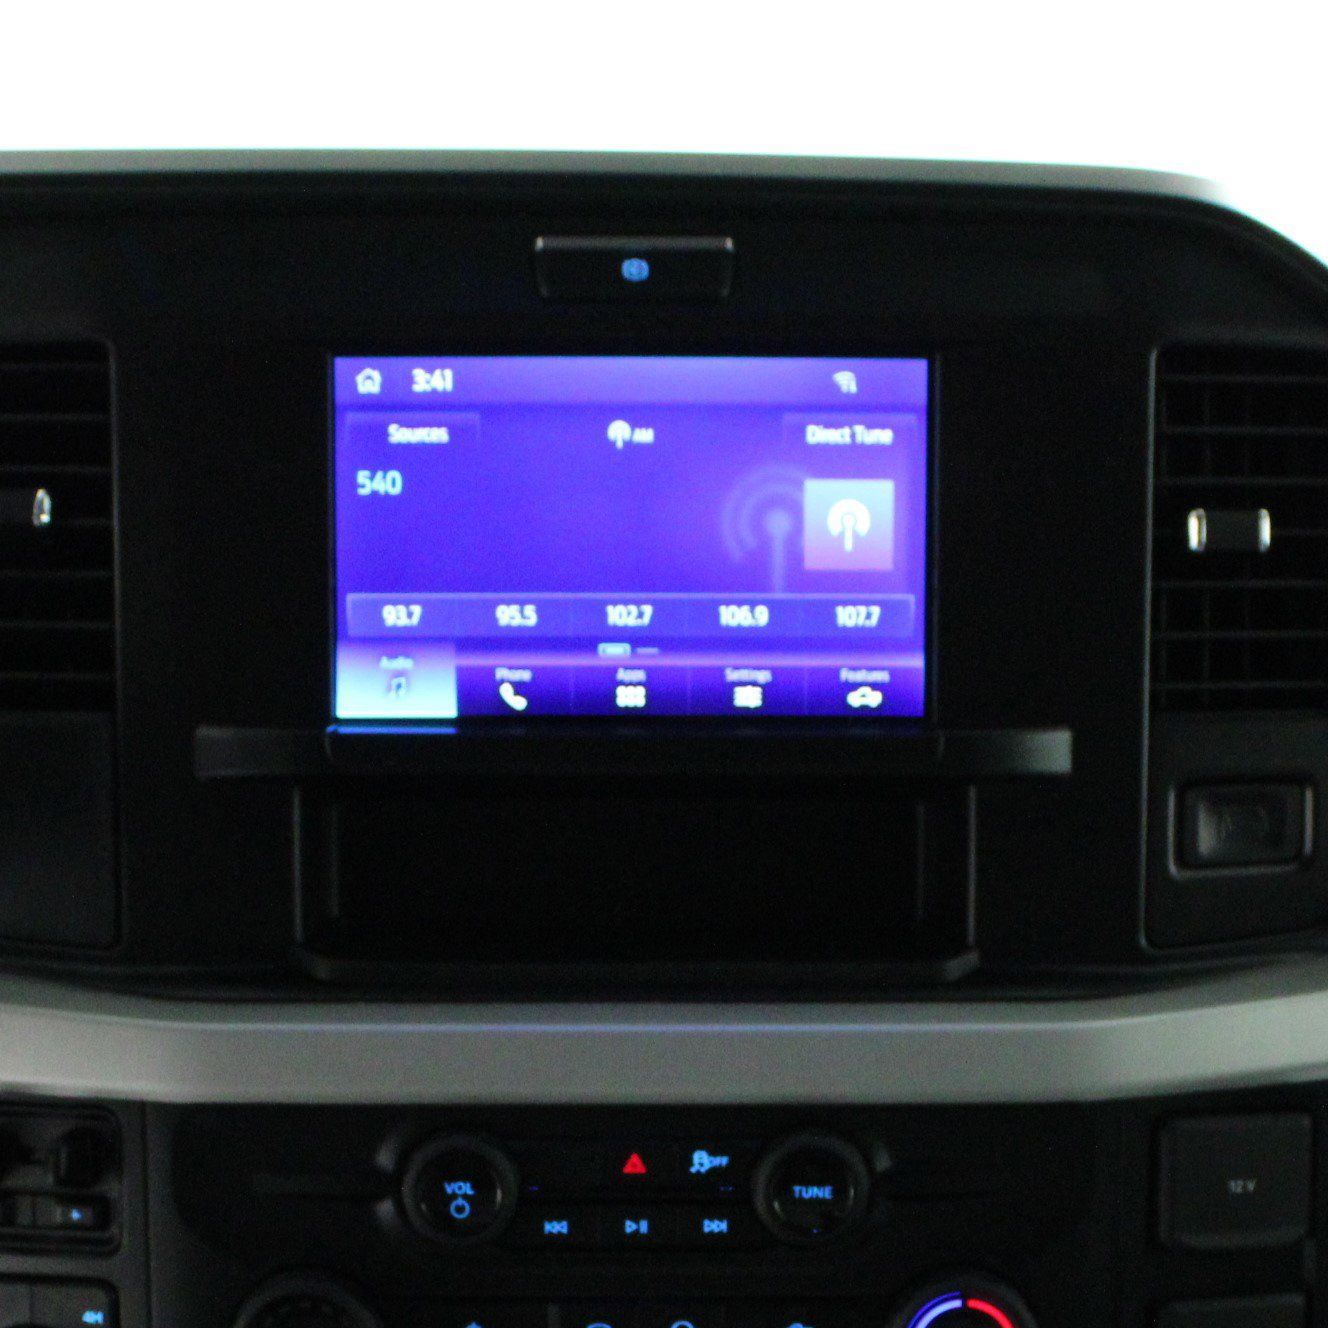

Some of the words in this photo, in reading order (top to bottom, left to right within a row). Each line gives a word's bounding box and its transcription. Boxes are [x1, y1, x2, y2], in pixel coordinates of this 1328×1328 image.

[412, 368, 453, 393] 3:41
[388, 423, 449, 444] Sources
[805, 425, 851, 445] Direct
[852, 425, 894, 445] Tune
[356, 470, 402, 495] 540
[382, 604, 422, 627] 93.7
[495, 604, 538, 627] 95.5
[606, 604, 653, 626] 102.7
[719, 604, 769, 626] 106.9
[835, 605, 881, 627] 107.7
[444, 1181, 475, 1195] VOL
[793, 1186, 833, 1199] TUNE
